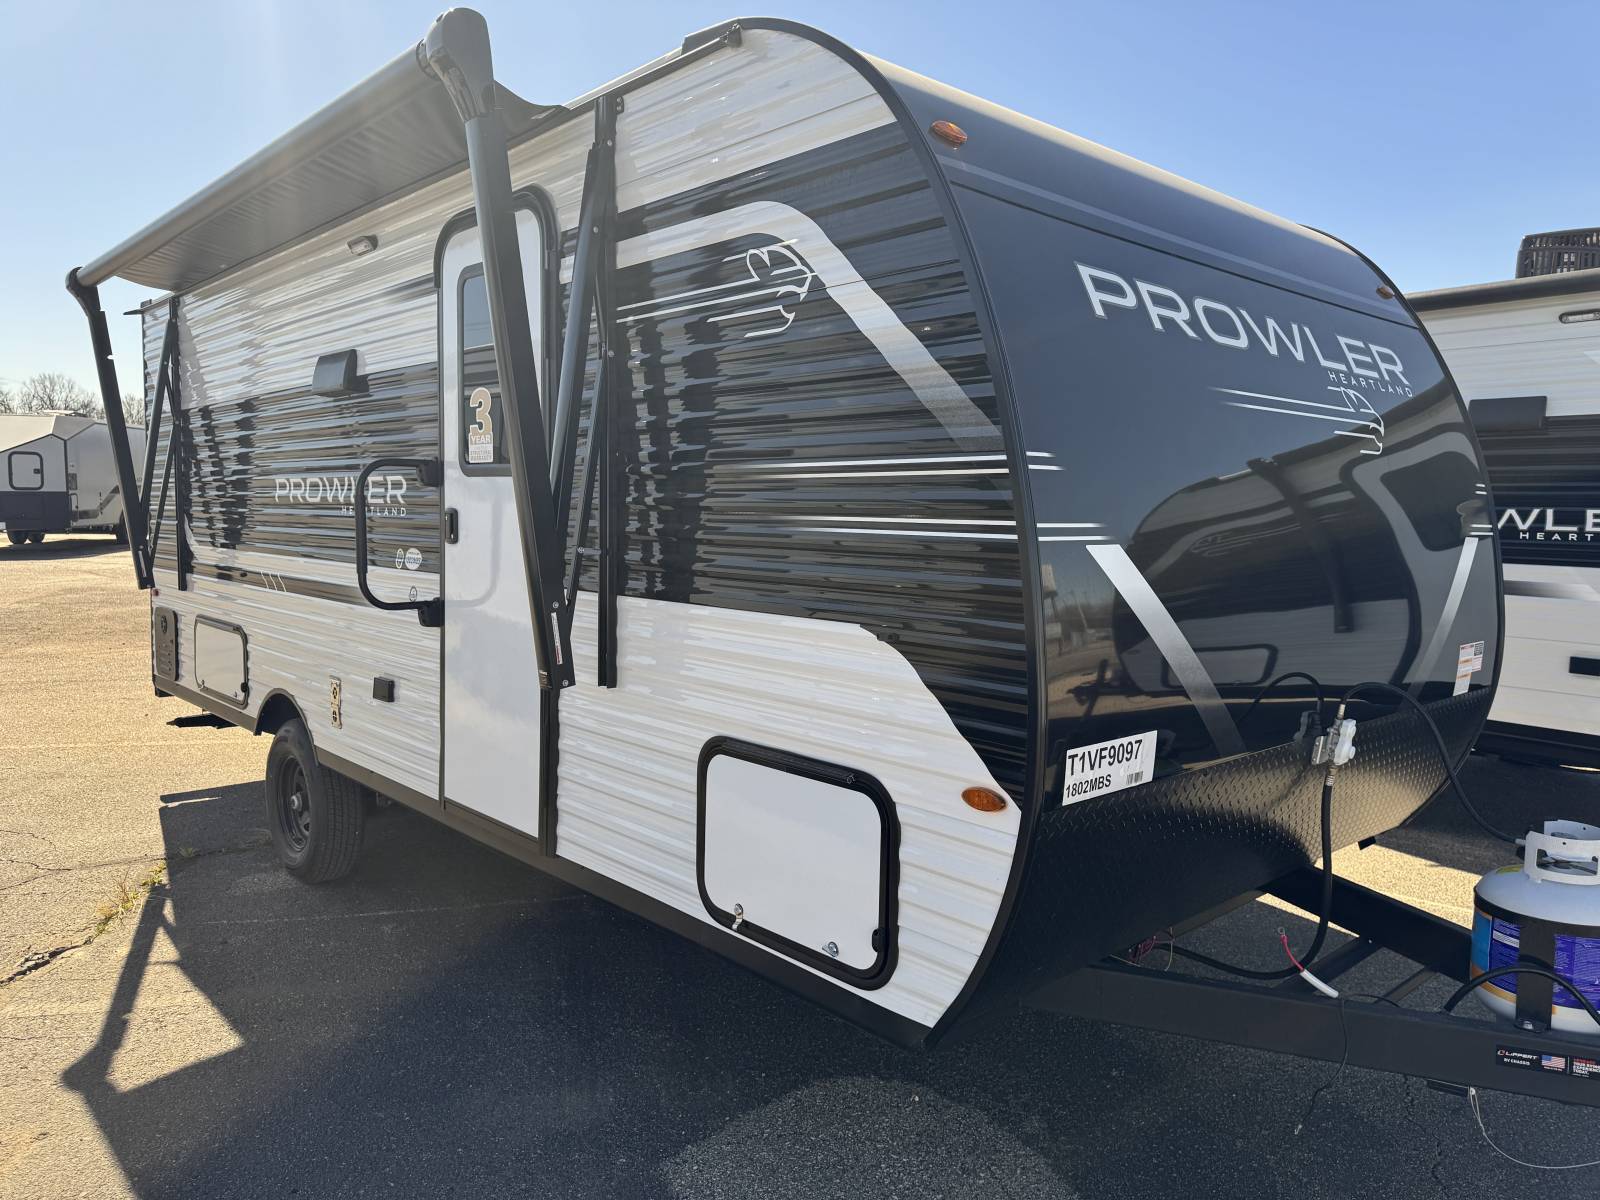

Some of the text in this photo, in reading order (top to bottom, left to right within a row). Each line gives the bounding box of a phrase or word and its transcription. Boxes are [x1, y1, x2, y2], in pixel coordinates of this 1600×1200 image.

[1075, 262, 1411, 386] PROWLER
[1328, 370, 1413, 397] HEARTLAND
[470, 387, 492, 434] 3
[471, 435, 491, 445] YEAR
[1068, 739, 1142, 776] T1VF9097
[1066, 774, 1112, 798] 1802MBS
